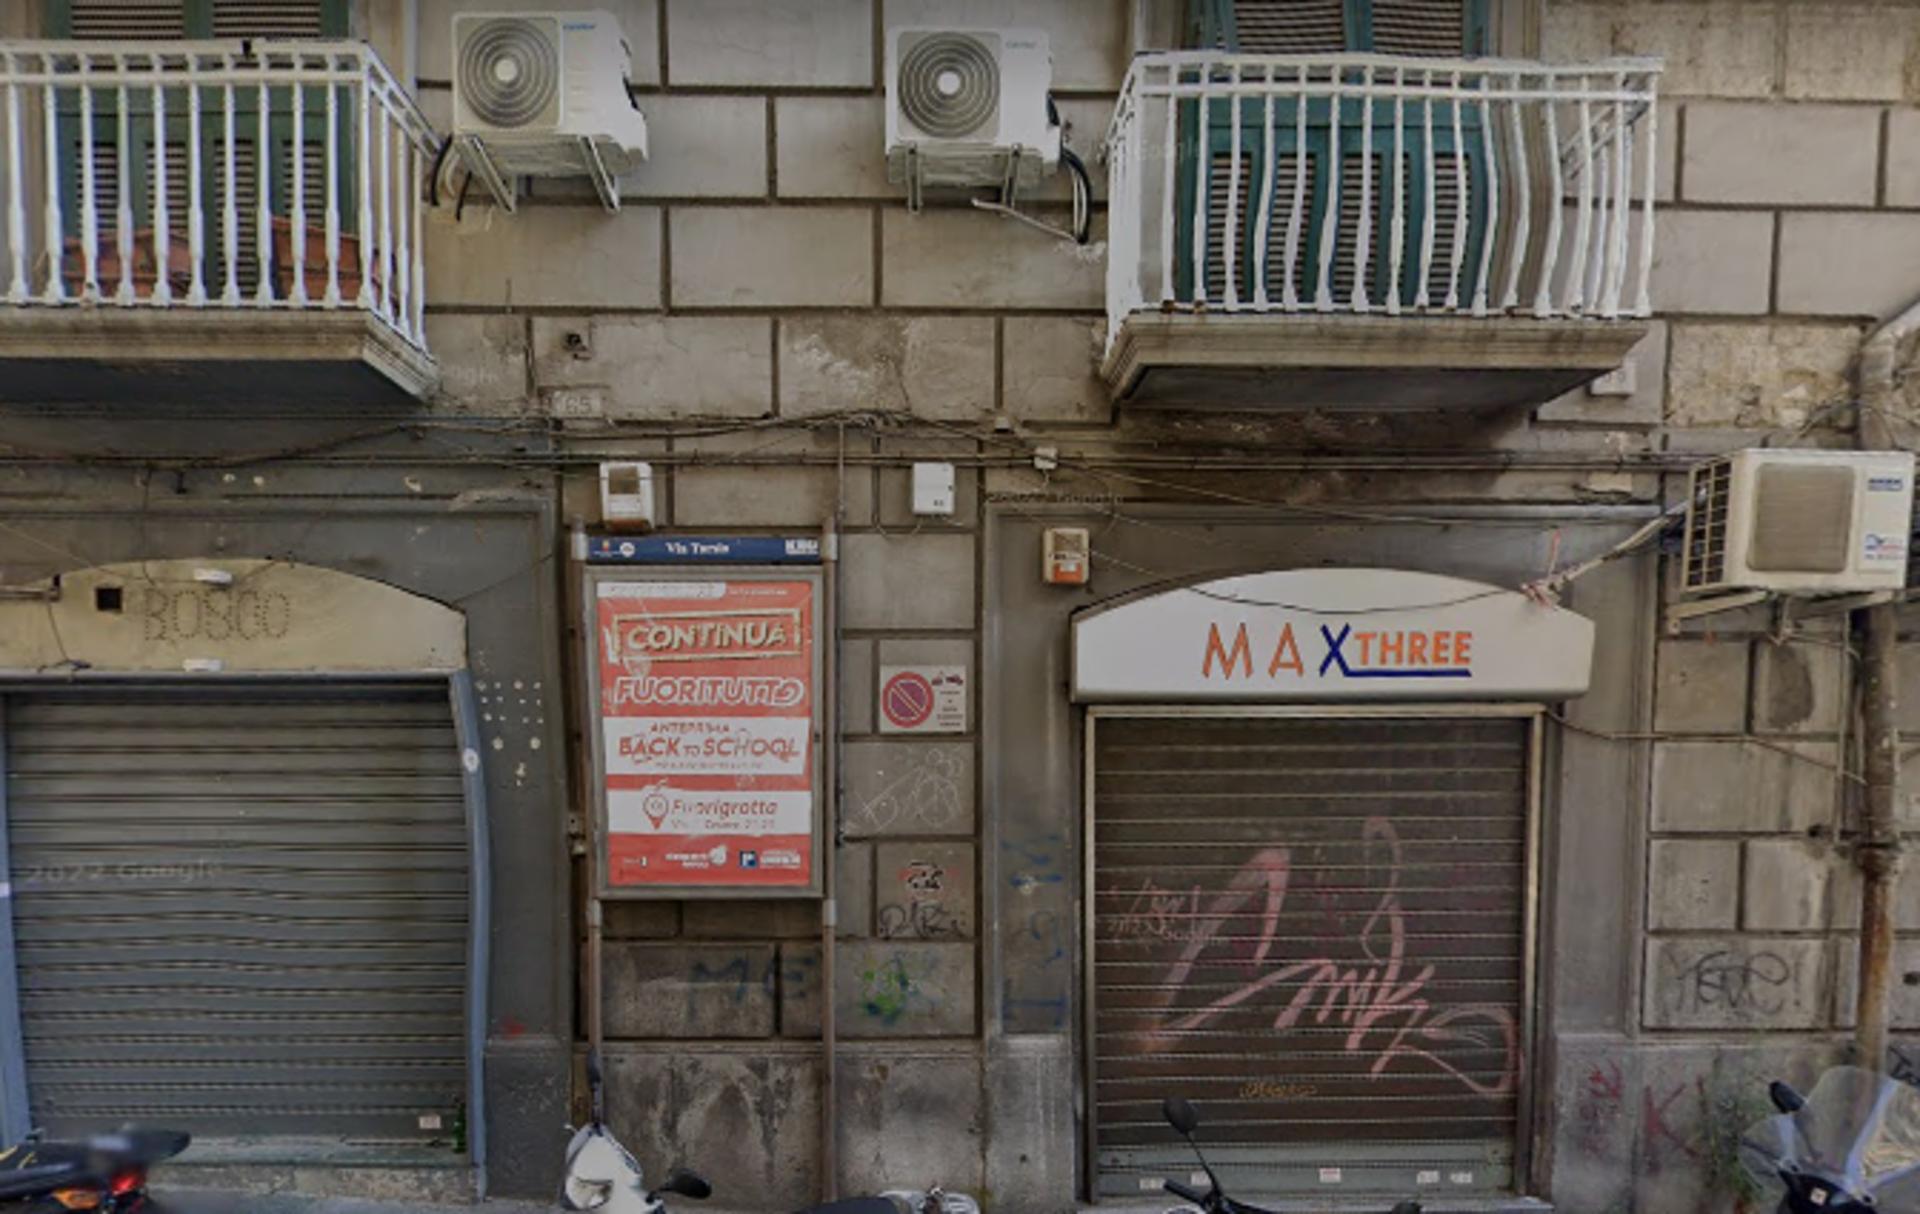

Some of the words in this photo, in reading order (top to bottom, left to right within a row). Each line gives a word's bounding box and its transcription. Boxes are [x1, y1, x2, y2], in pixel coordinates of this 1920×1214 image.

[627, 622, 787, 651] CONTINUA
[1354, 631, 1473, 666] THREE
[619, 736, 681, 756] BACK
[703, 736, 801, 758] SCHOOL
